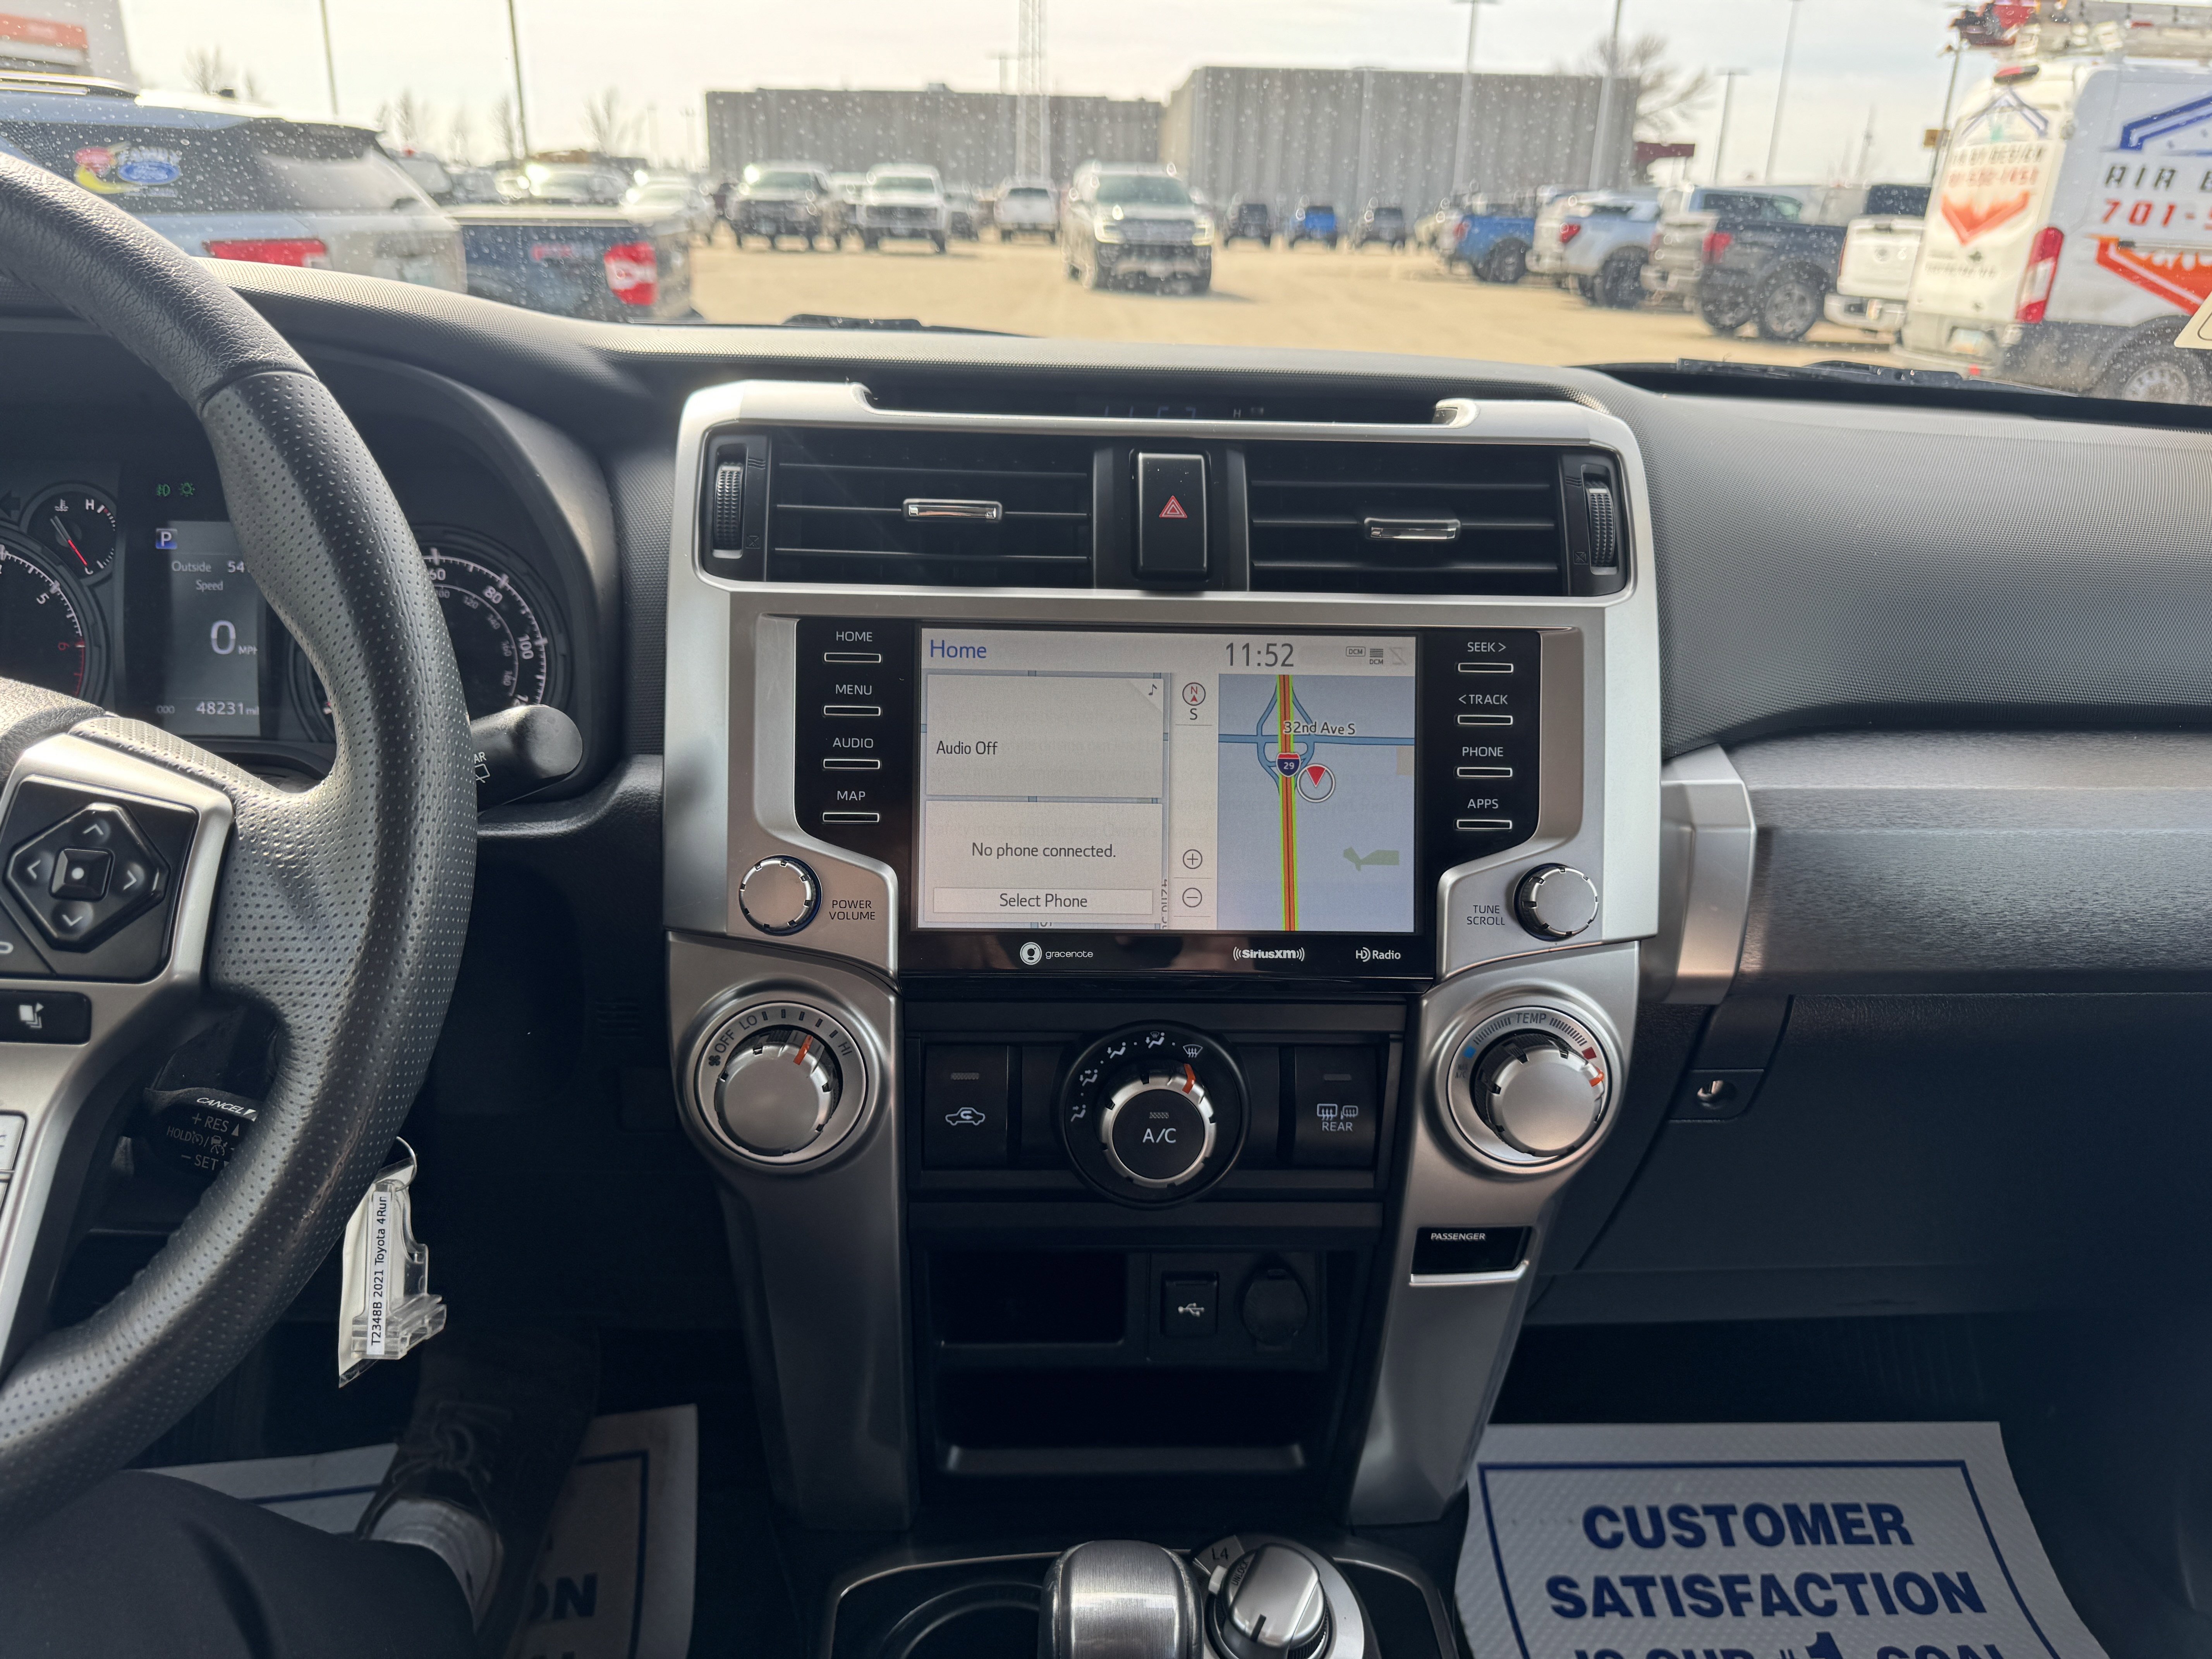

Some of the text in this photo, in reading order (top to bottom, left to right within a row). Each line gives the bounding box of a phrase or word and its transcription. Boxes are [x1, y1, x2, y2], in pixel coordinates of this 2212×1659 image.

[86, 499, 94, 510] H
[161, 532, 172, 547] P
[172, 560, 211, 572] Outside
[196, 579, 223, 592] Speed
[36, 592, 50, 604] 5
[484, 585, 503, 604] 80
[211, 620, 236, 654] 0
[836, 631, 873, 642] HOME
[519, 634, 534, 659] 100
[930, 640, 987, 658] Home
[1226, 642, 1294, 667] 11:52
[835, 685, 872, 695] MENU
[1191, 686, 1198, 694] N
[1469, 695, 1508, 704] TRACK
[196, 701, 244, 715] 48231
[1190, 708, 1197, 720] S
[1283, 721, 1355, 735] 32nd Ave S
[833, 738, 874, 749] AUDIO
[936, 741, 998, 755] Audio Off
[474, 752, 487, 764] AR
[1462, 747, 1503, 756] PHONE
[1284, 762, 1295, 770] 29
[836, 791, 866, 801] MAP
[1467, 799, 1499, 809] APPS
[972, 842, 1116, 859] No phone connected.
[832, 900, 872, 908] POWER
[1000, 893, 1087, 908] Select Phone
[829, 912, 875, 920] VOLUME
[1473, 905, 1500, 914] TUNE
[1467, 917, 1505, 926] SCROLL
[1046, 950, 1093, 960] gracenote
[1372, 950, 1401, 960] Radio
[739, 1015, 757, 1030] LO
[1516, 1012, 1547, 1024] TEMP
[715, 1029, 735, 1054] OFF
[838, 1041, 852, 1056] HI
[196, 1097, 244, 1114] CANCEL
[204, 1116, 229, 1132] RES
[1322, 1122, 1353, 1132] REAR
[167, 1126, 192, 1141] HOLD
[1142, 1128, 1176, 1143] A/C
[194, 1154, 219, 1171] SET
[1431, 1233, 1486, 1241] PASSENGER
[375, 1228, 388, 1266] Toyota
[373, 1270, 384, 1298] 2021
[371, 1303, 384, 1346] T2348B
[1582, 1502, 1915, 1549] CUSTOMER
[1212, 1547, 1228, 1560] L4
[1545, 1570, 1987, 1618] SATISFACTION
